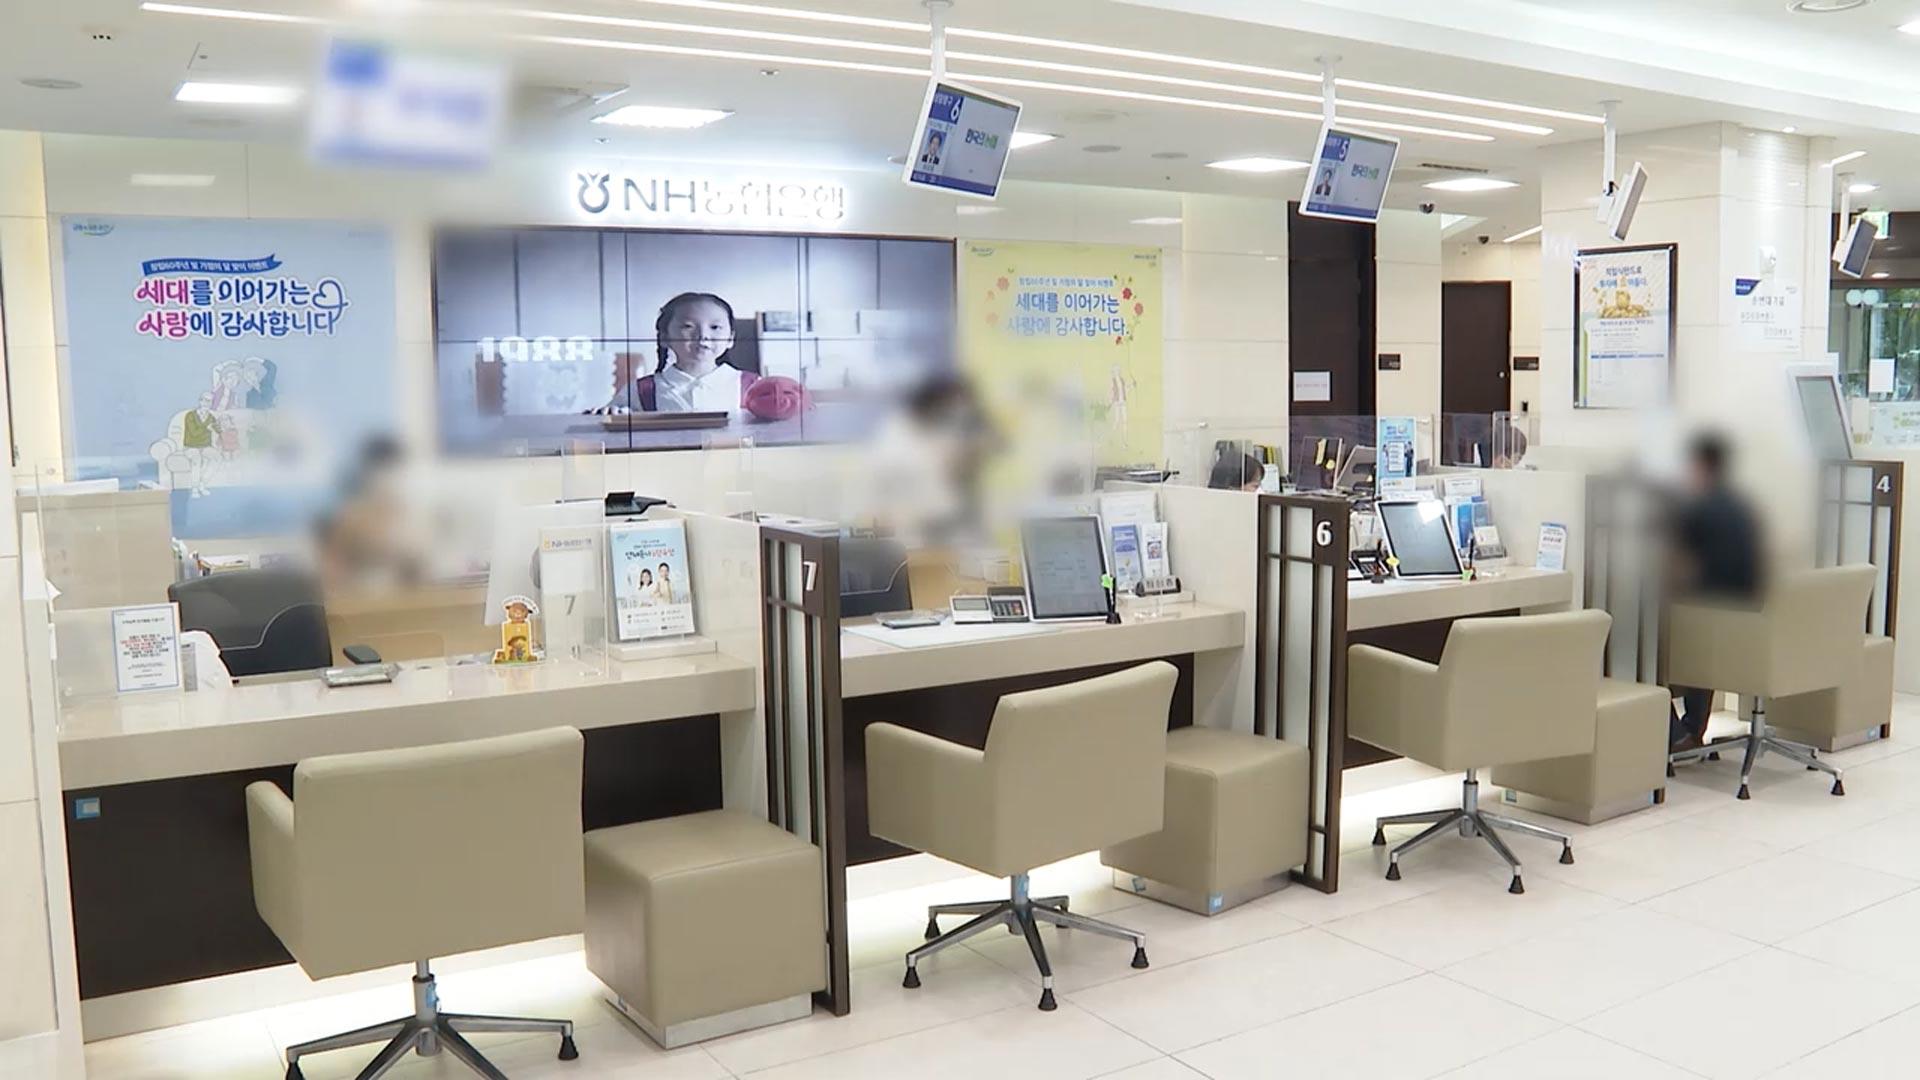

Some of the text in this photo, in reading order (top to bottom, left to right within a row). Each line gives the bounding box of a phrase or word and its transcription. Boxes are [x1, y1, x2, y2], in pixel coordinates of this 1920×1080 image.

[951, 98, 961, 120] 6
[1339, 140, 1349, 159] 5
[136, 279, 310, 306] 세대를 이어가는
[1016, 292, 1120, 314] 세대를 이어가는
[139, 310, 333, 338] 사랑에 감사합니다
[1007, 316, 1130, 337] 사랑에 감사합니다.
[1876, 475, 1891, 493] 4
[1316, 521, 1332, 546] 6
[803, 561, 817, 591] 7
[564, 594, 577, 616] 7
